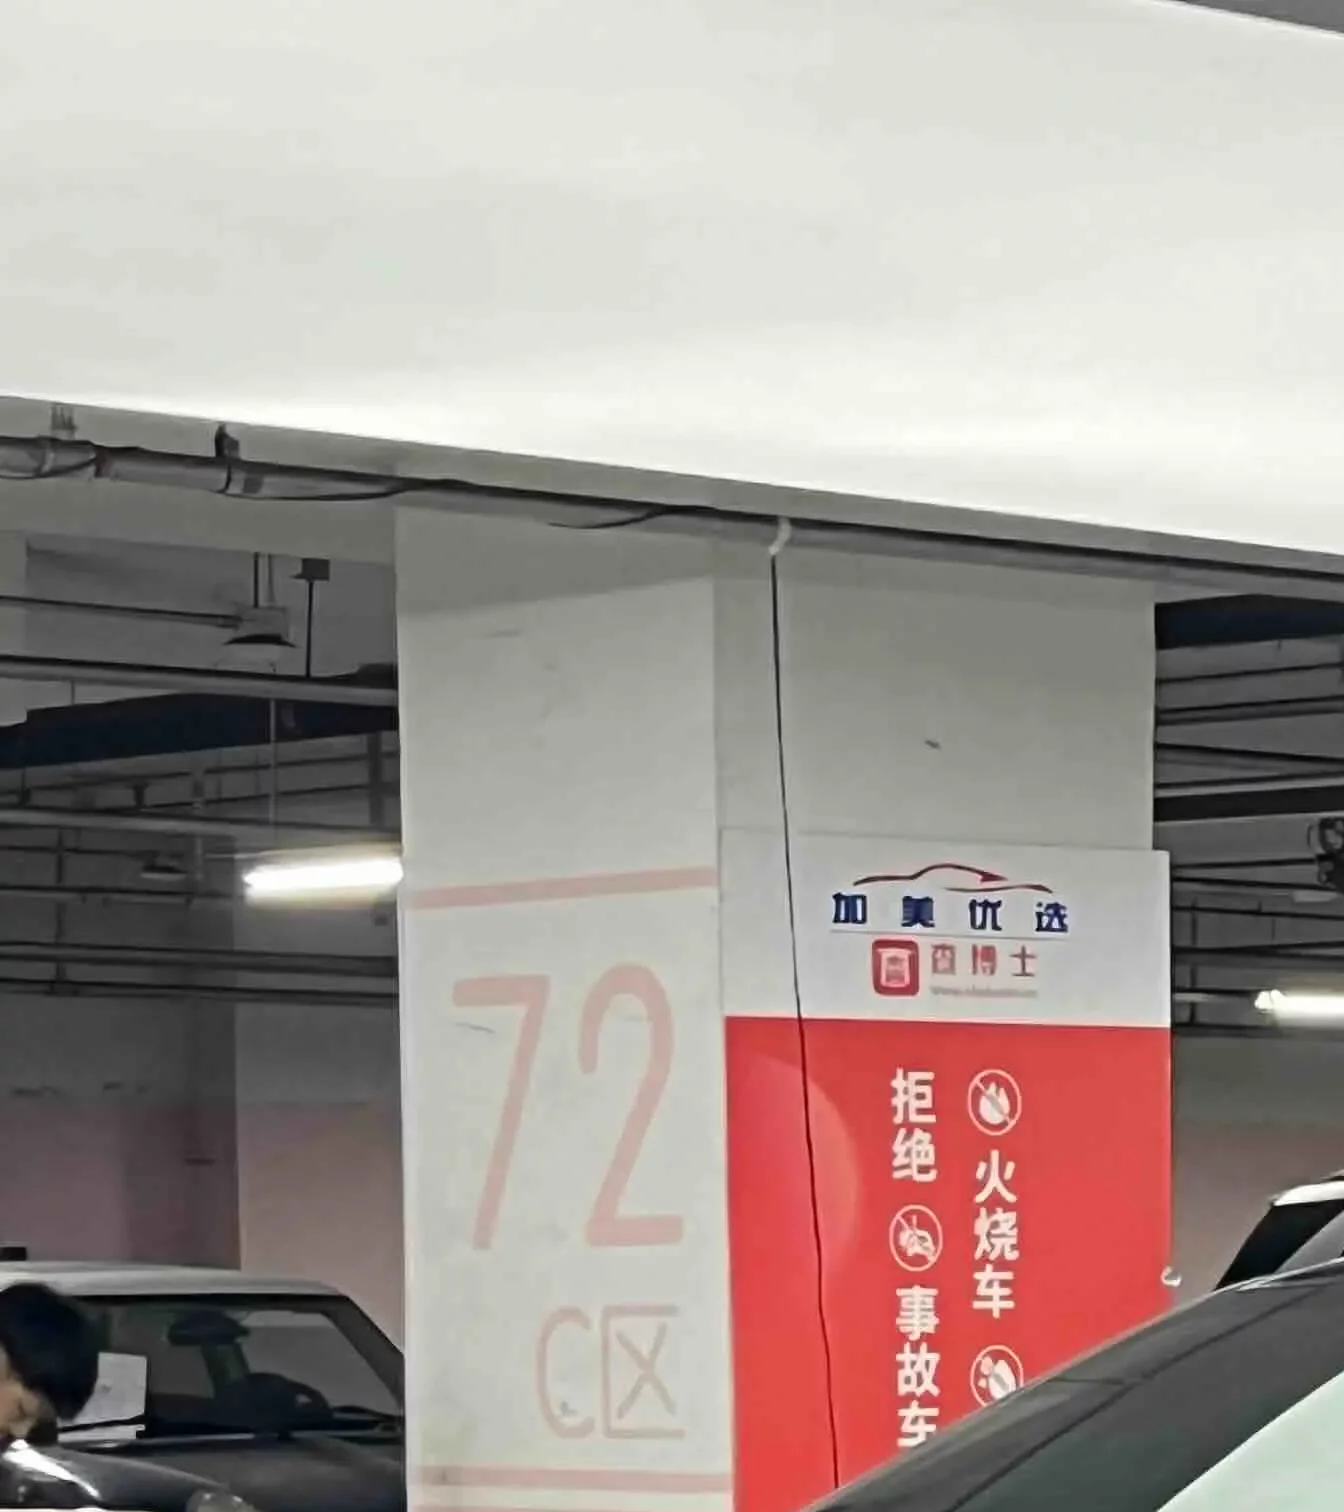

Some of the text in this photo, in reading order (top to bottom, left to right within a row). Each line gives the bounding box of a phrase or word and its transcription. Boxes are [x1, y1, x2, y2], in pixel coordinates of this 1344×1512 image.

[832, 892, 1068, 933] 加美优选
[452, 961, 684, 1250] 72
[890, 1068, 940, 1447] 拒绝 事故车
[973, 1149, 1020, 1319] 火烧车
[536, 1304, 686, 1439] C区
